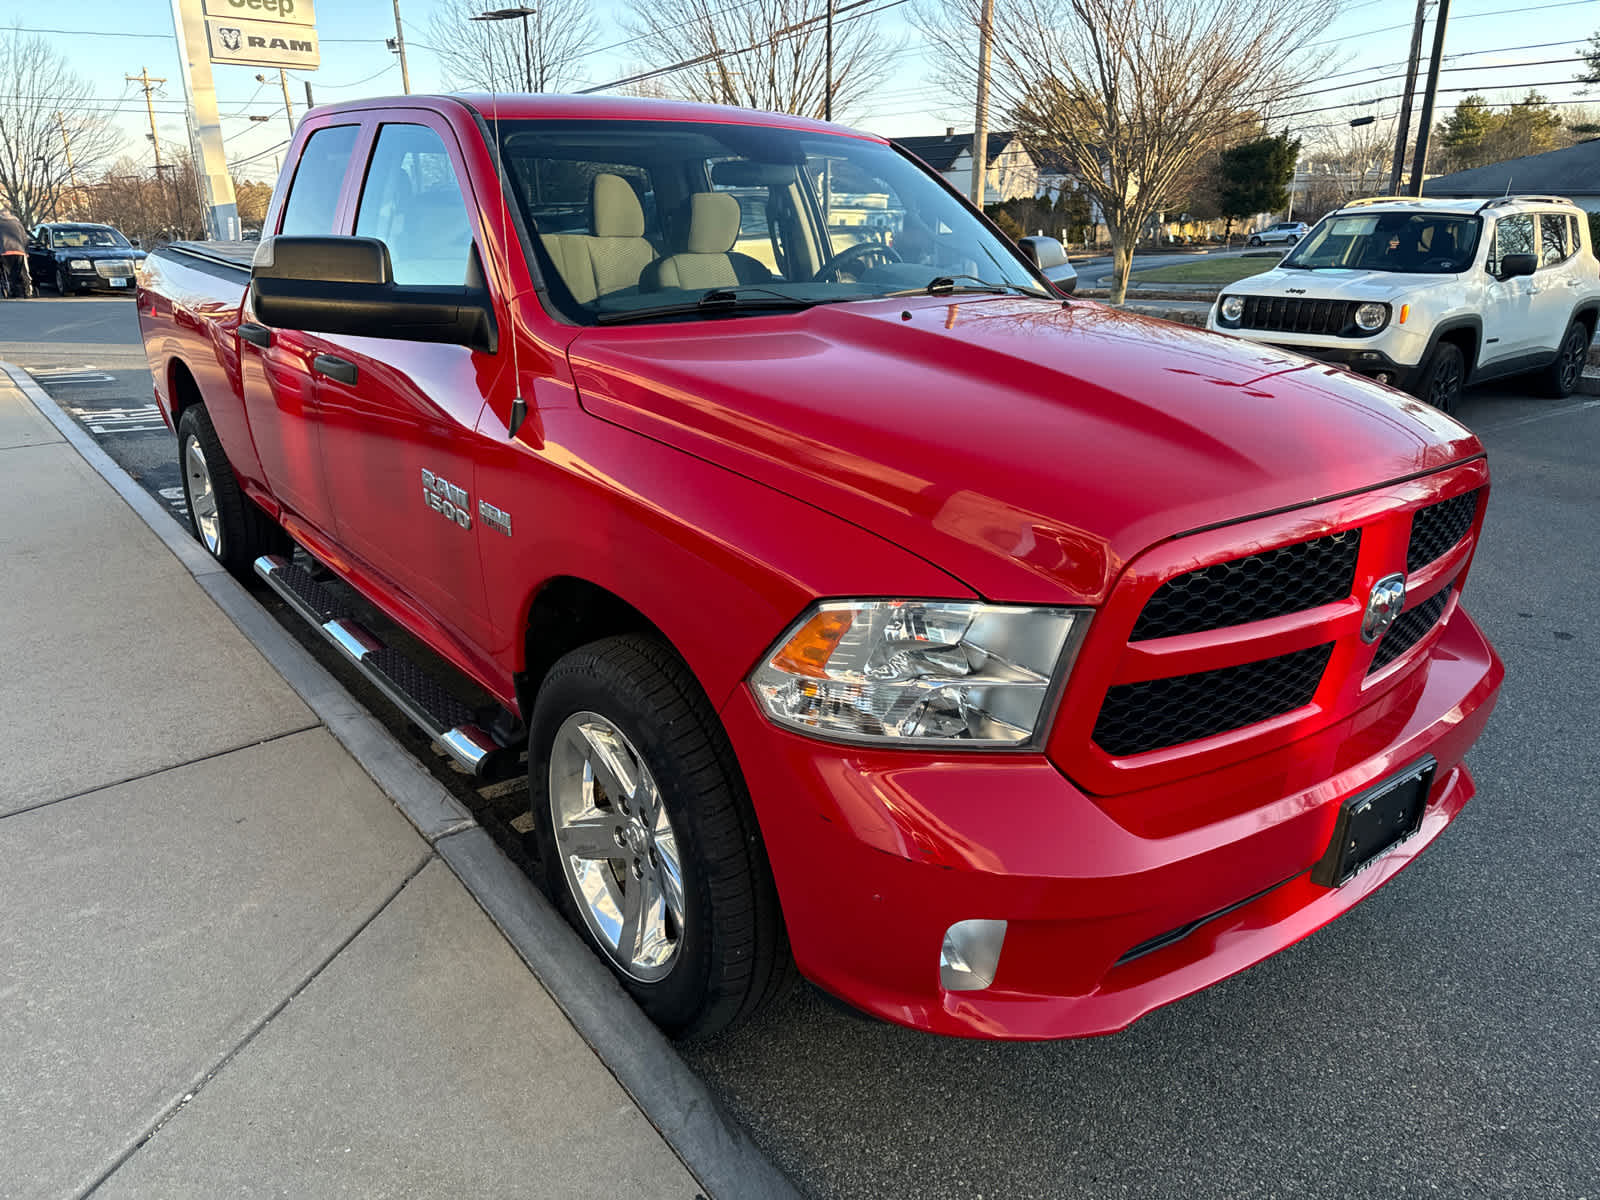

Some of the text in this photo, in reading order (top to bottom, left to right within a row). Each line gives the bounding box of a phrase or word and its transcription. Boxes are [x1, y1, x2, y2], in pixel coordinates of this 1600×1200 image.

[247, 36, 313, 52] RAM
[421, 467, 469, 511] RAM
[423, 487, 472, 530] 1500
